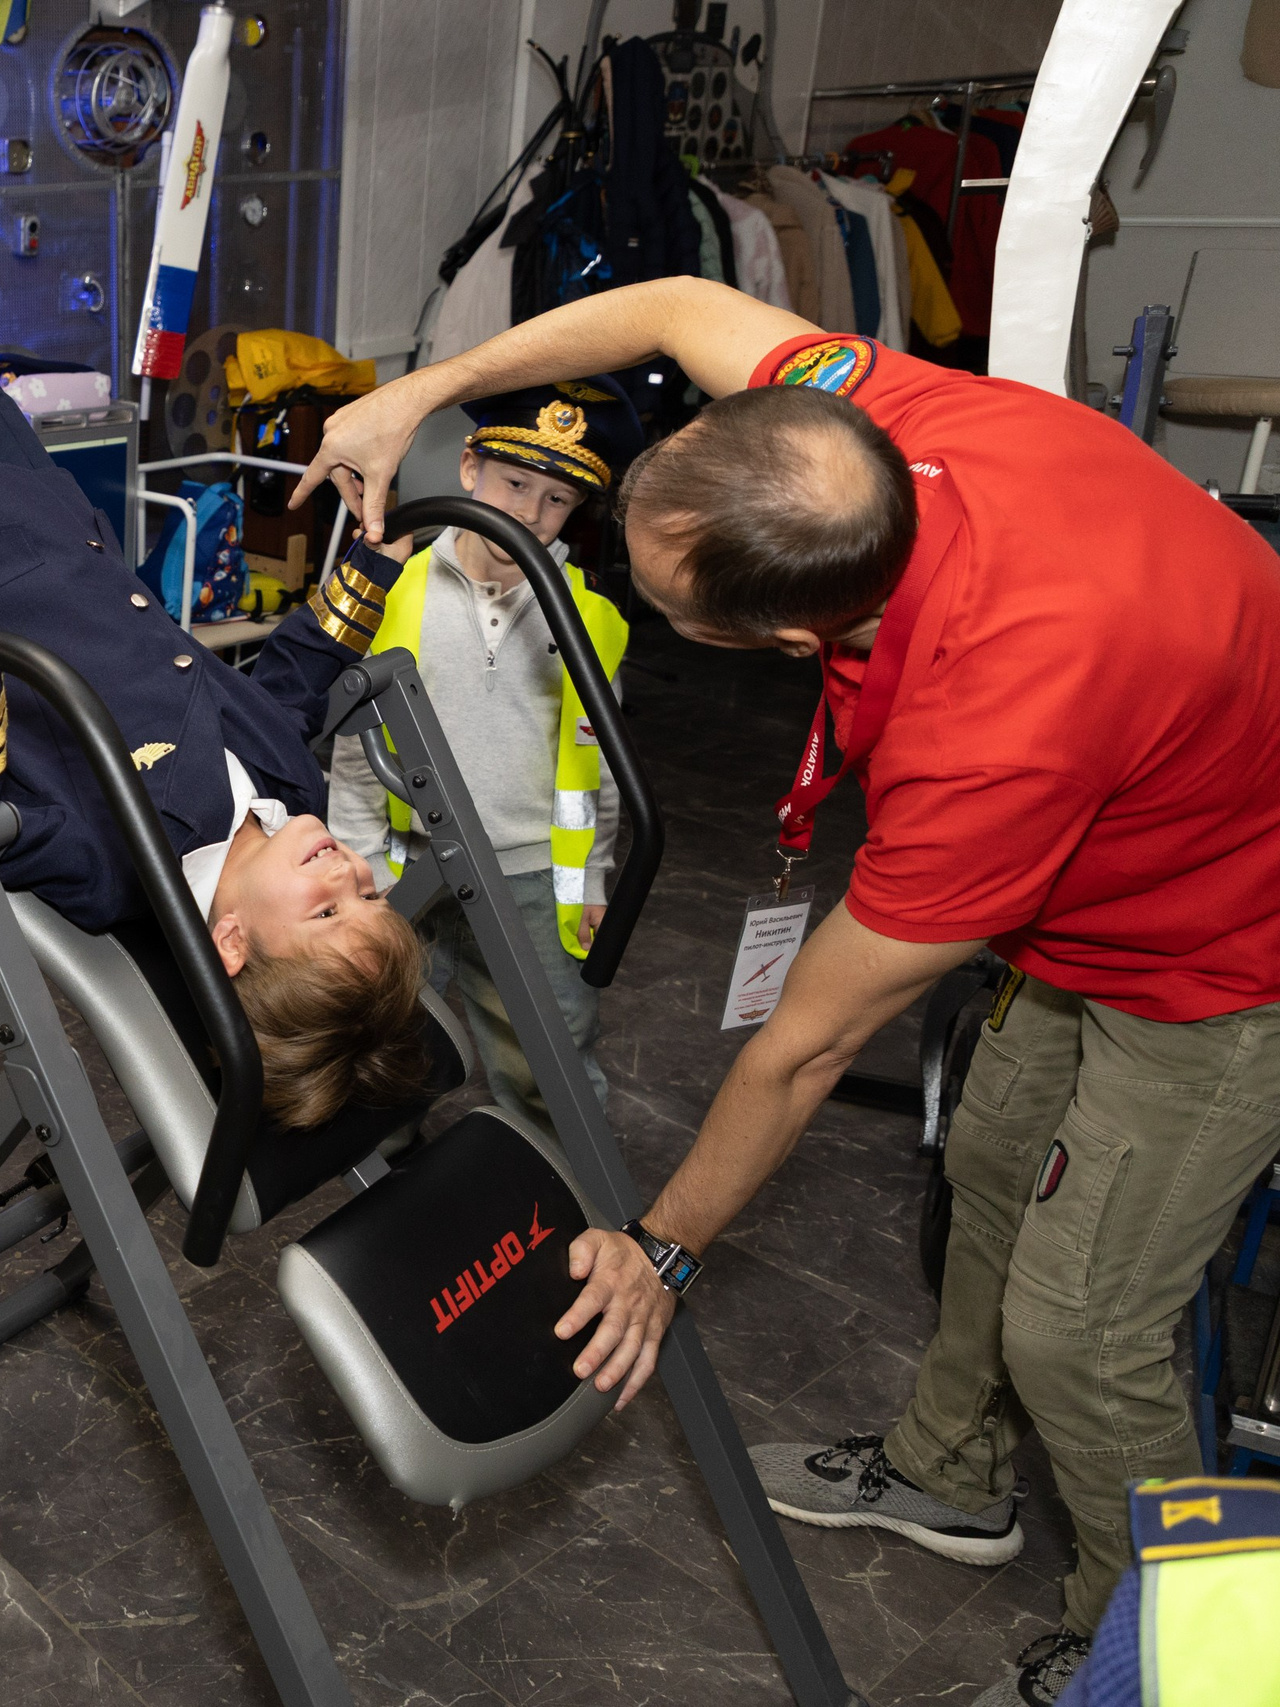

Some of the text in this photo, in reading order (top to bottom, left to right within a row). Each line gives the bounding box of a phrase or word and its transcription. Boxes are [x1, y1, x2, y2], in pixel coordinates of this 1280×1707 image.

[749, 912, 803, 927] Юрий Васильевич
[755, 926, 792, 939] Никитин
[743, 937, 797, 951] пилот-инструктор
[429, 1231, 526, 1334] OPTIFIT
